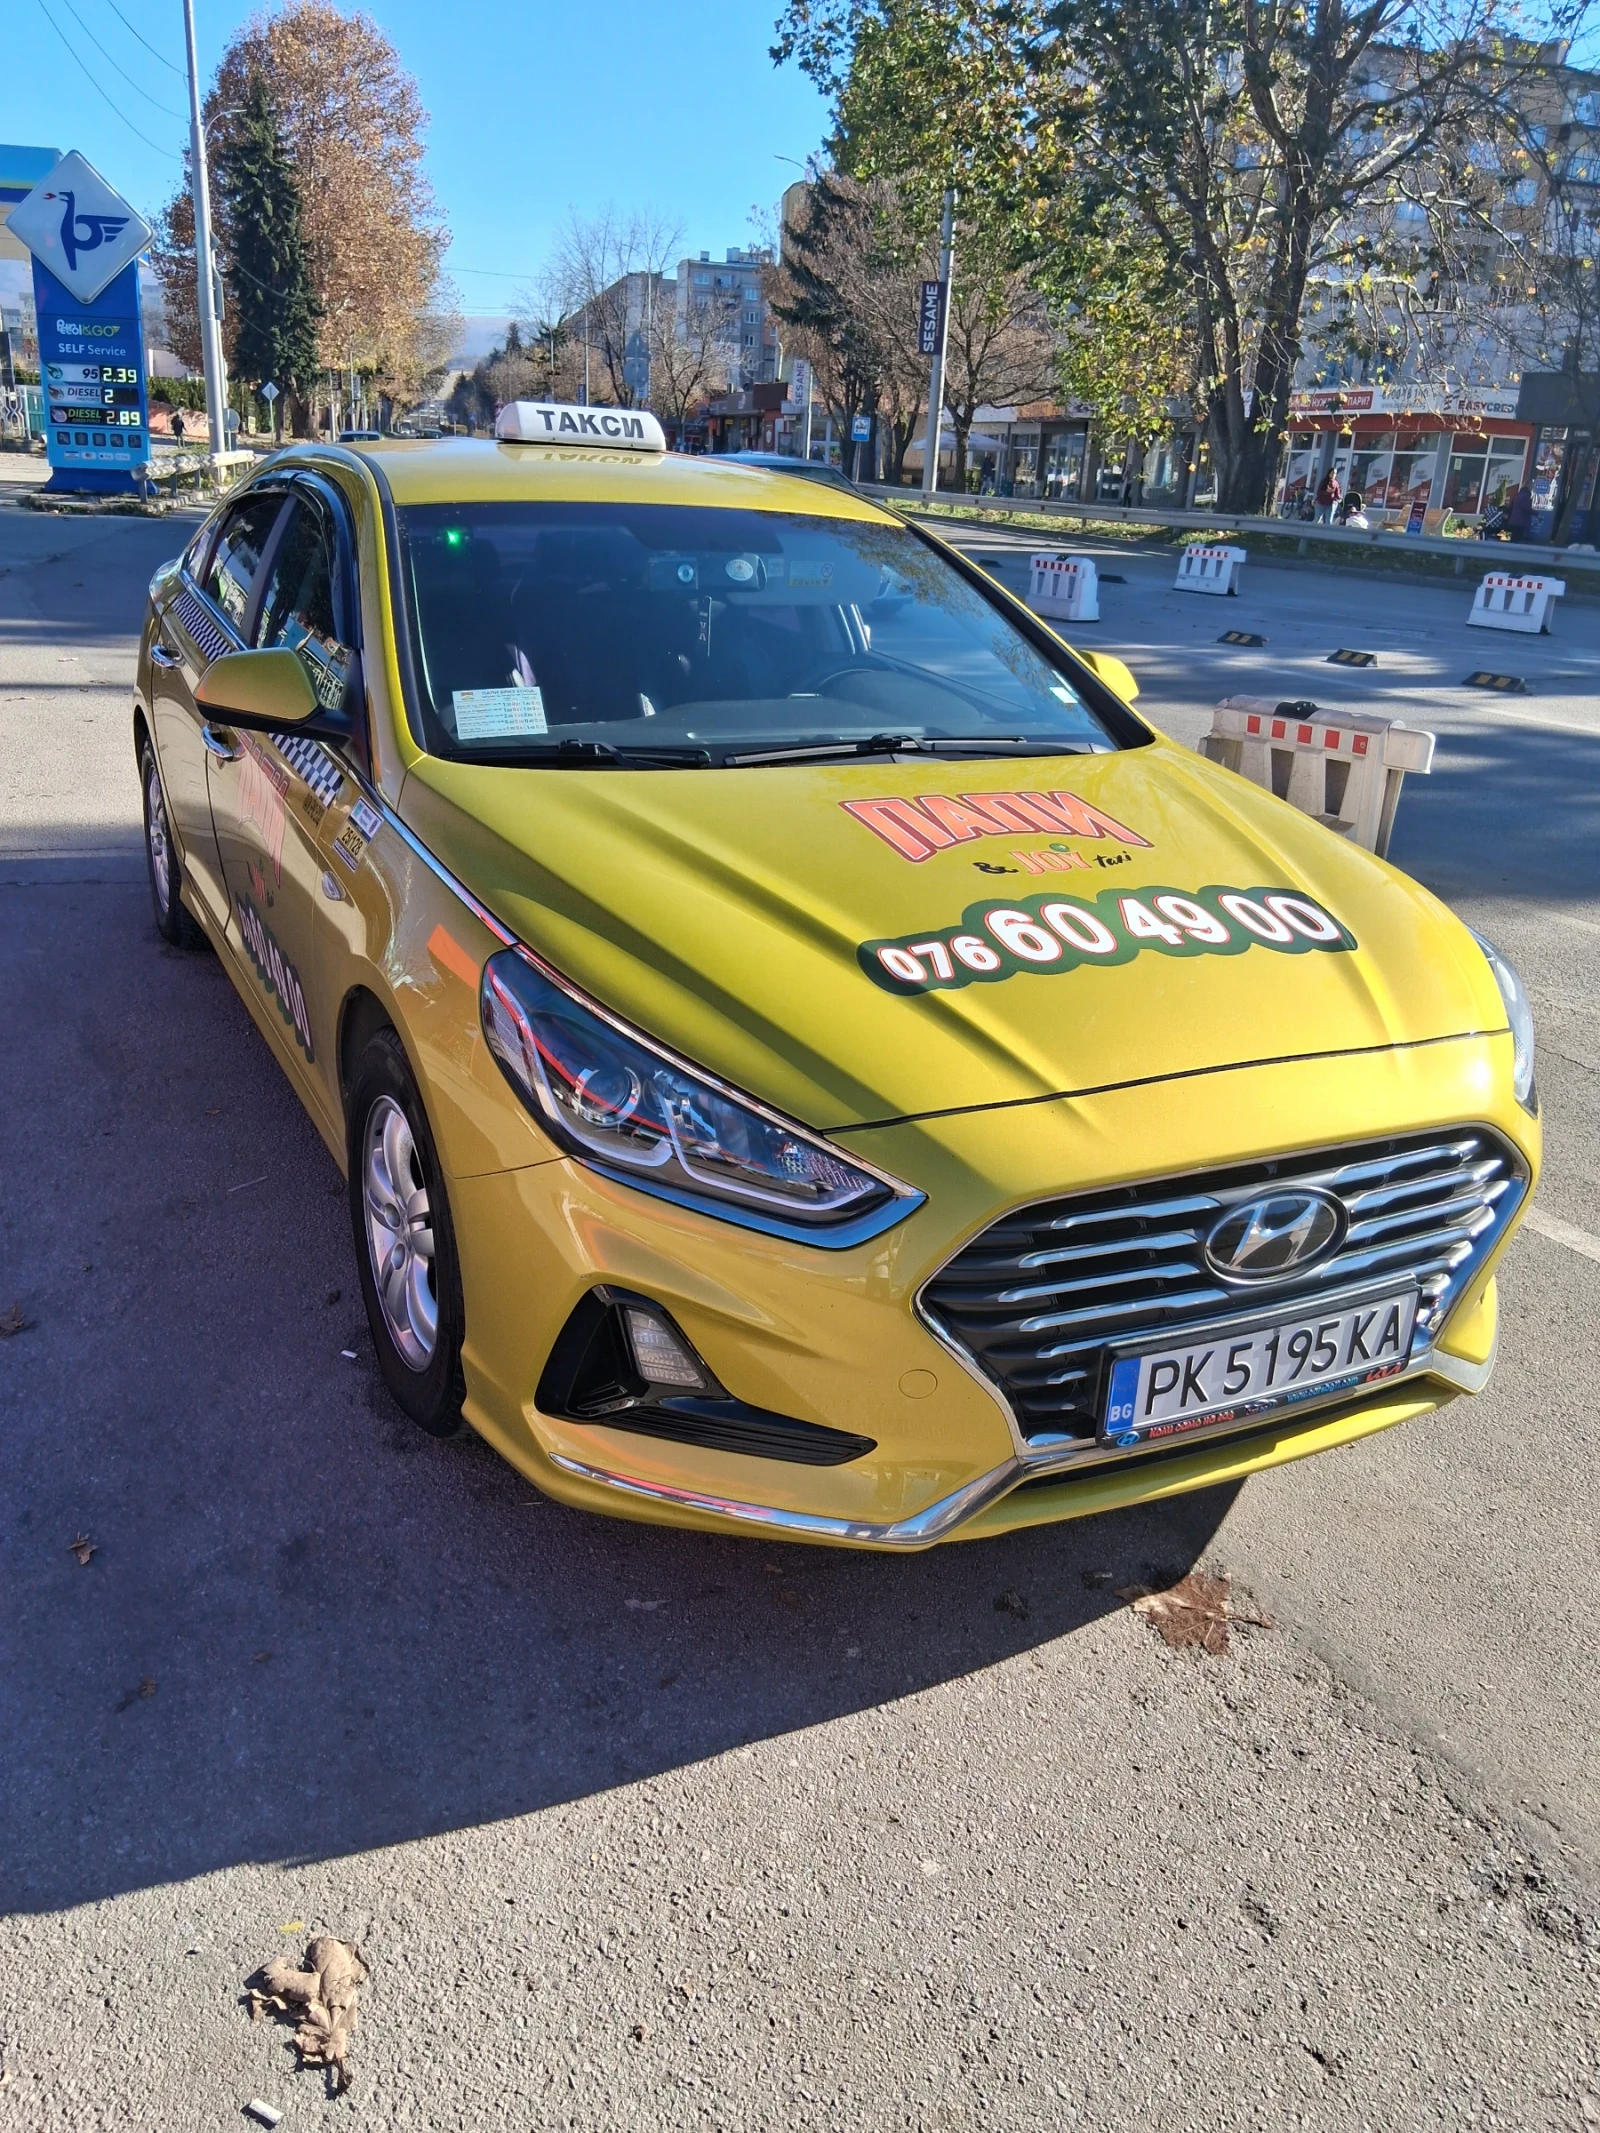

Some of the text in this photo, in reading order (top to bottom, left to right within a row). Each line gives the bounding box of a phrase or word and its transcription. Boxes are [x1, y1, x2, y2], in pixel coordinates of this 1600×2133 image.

[923, 284, 938, 352] SESAME
[58, 343, 126, 356] SELF Service
[82, 368, 99, 379] 95
[103, 367, 137, 384] 2.39
[795, 362, 805, 405] SESAME
[67, 387, 100, 397] DIESEL
[1348, 395, 1370, 408] ПАРИ?
[68, 408, 140, 426] DIESEL 2.89
[1458, 399, 1516, 413] EASYCRED
[536, 409, 644, 439] ТАКСИ
[839, 791, 1154, 862] ПАПИ
[1009, 848, 1100, 876] JOY
[877, 894, 1342, 982] 076 60 49 00
[1145, 1351, 1214, 1415] PK
[1223, 1319, 1342, 1396] 5195
[1110, 1403, 1133, 1421] BG
